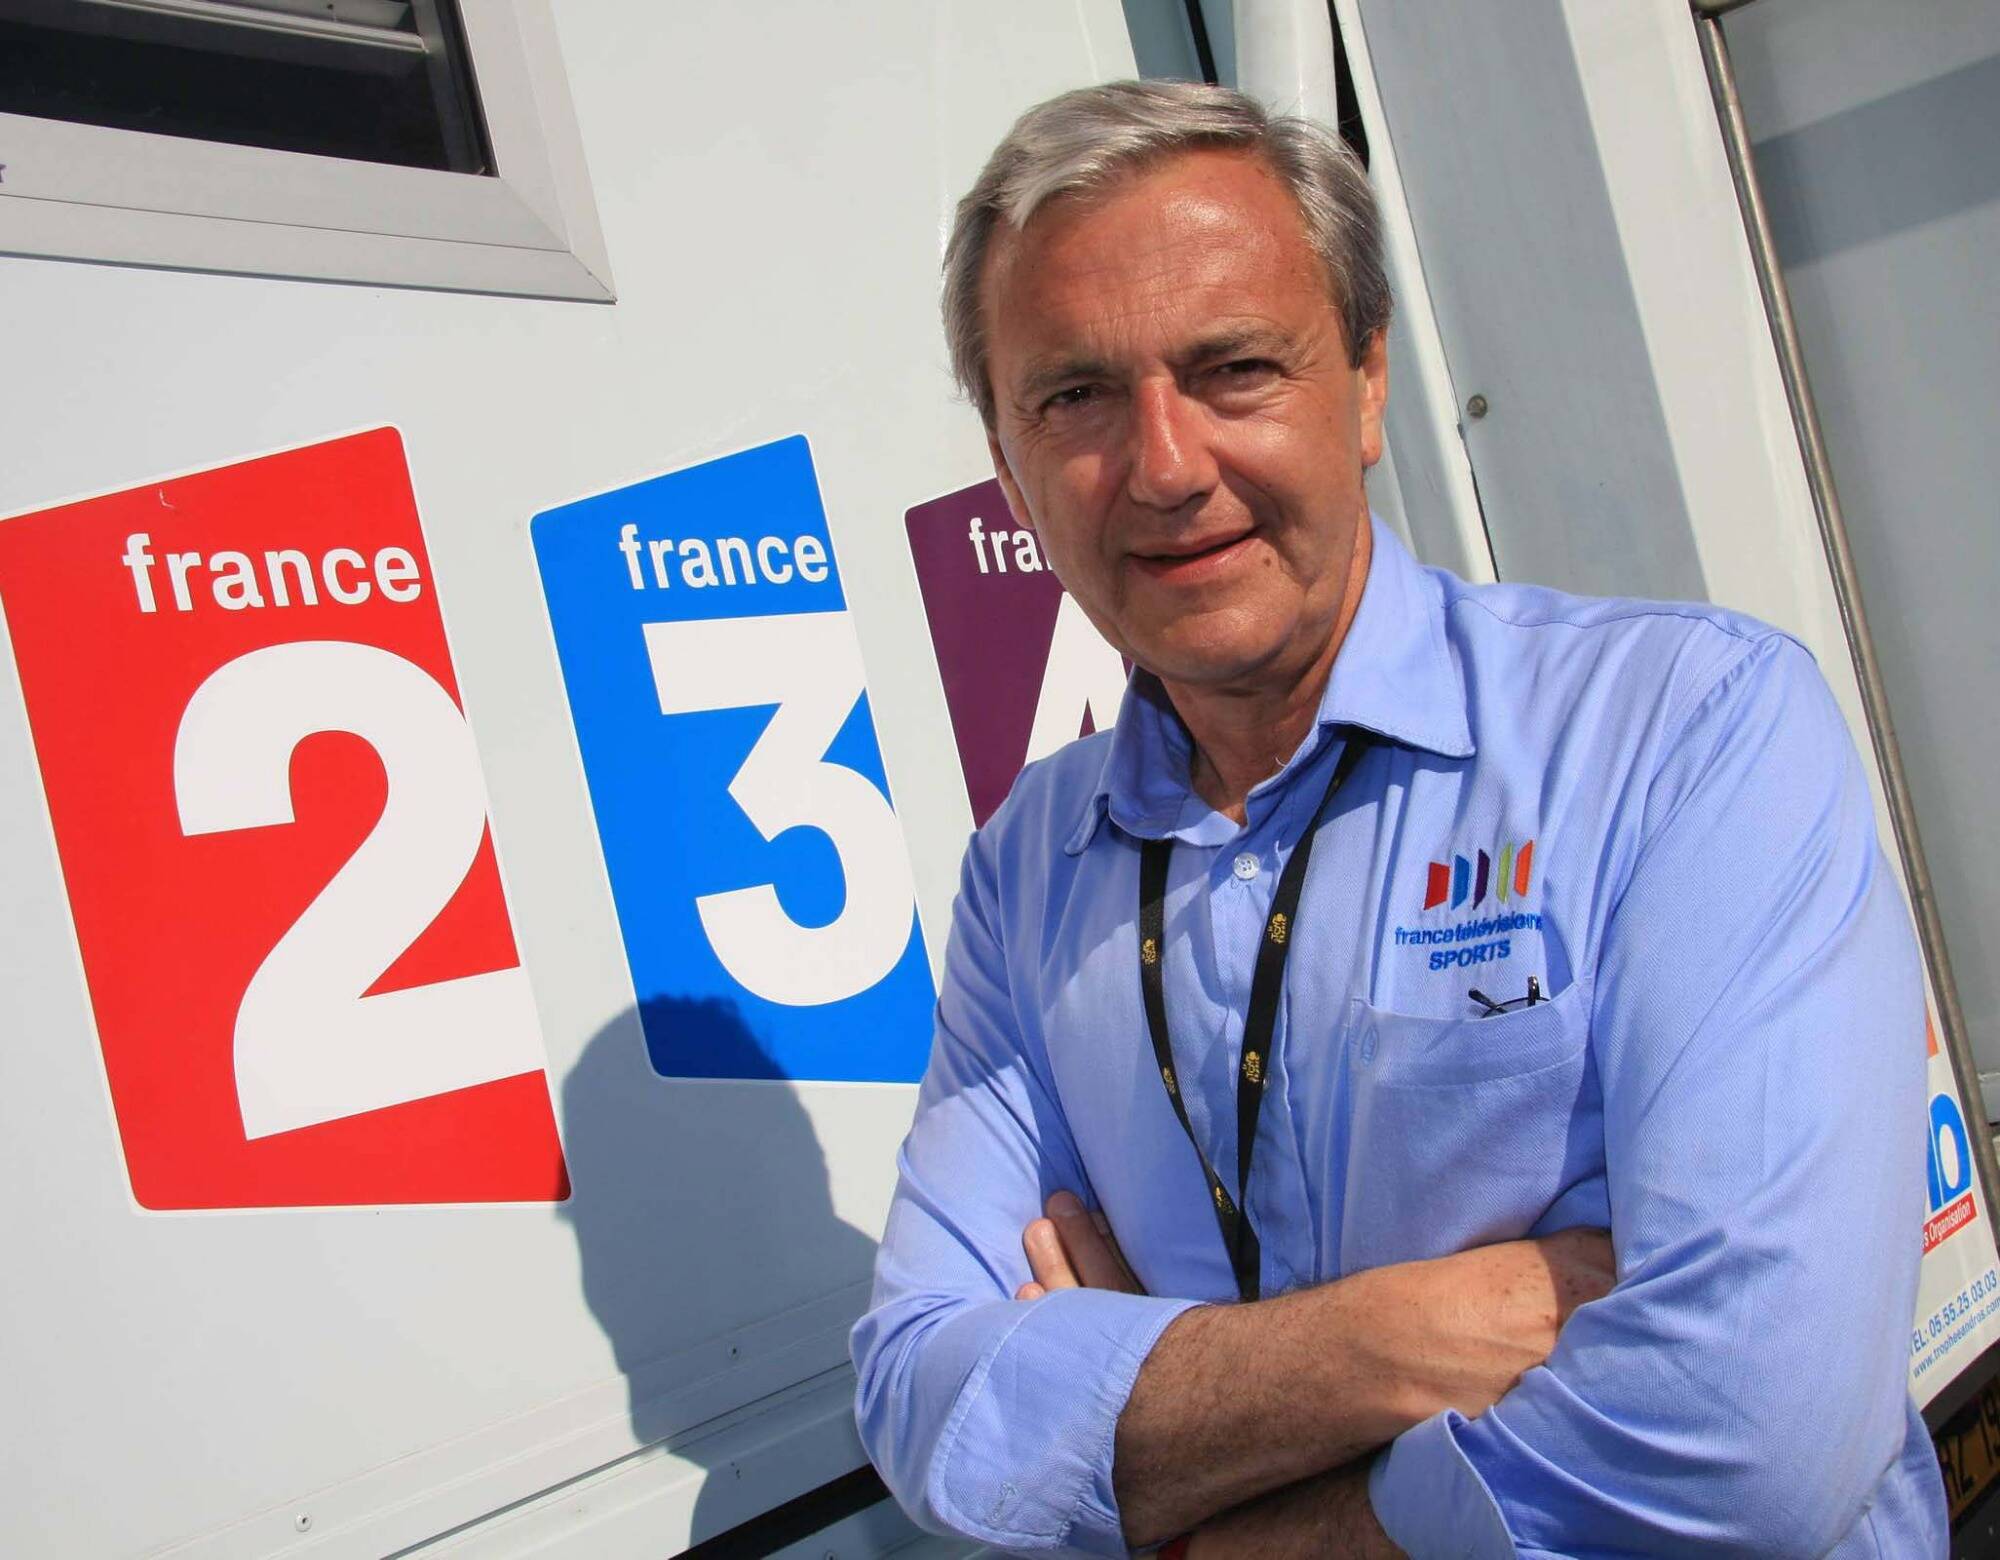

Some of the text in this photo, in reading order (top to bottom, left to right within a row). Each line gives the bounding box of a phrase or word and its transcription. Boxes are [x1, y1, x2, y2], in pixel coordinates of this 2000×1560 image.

[123, 532, 422, 614] france
[619, 523, 830, 590] france
[969, 517, 1054, 574] fra
[642, 610, 915, 1007] 3
[174, 640, 546, 1141] 2
[1429, 938, 1511, 970] SPORTS
[1910, 1269, 1997, 1356] EL: 05.55.25.03.03
